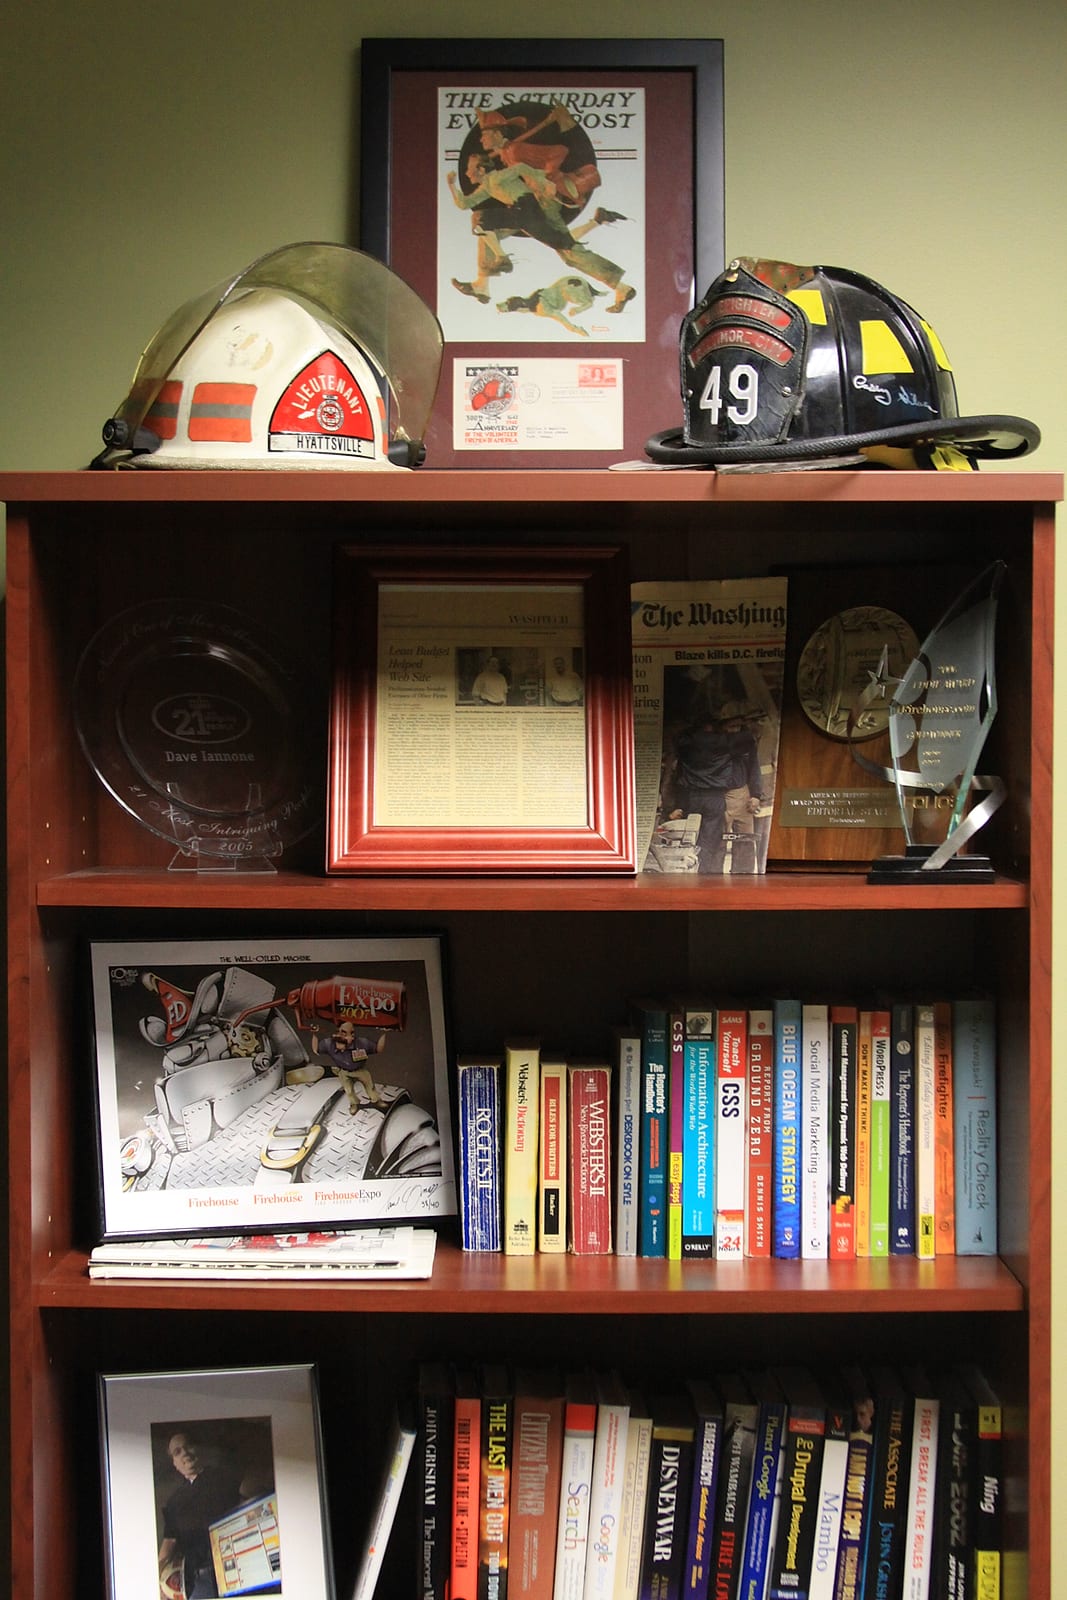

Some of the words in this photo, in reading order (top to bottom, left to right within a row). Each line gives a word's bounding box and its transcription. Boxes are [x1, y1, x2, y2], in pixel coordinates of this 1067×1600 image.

[445, 92, 493, 109] THE
[500, 92, 636, 113] SATURDAY
[291, 375, 363, 415] LIEUTENANT
[699, 363, 759, 425] 49
[296, 435, 362, 454] HYATTSVILLE
[642, 603, 684, 631] The
[688, 601, 786, 628] Washing
[388, 658, 424, 671] Helped
[415, 645, 450, 658] Budget
[675, 650, 705, 660] Blaze
[707, 649, 730, 660] kills
[732, 649, 754, 659] D.C.
[635, 668, 646, 678] to
[172, 708, 211, 736] 21
[165, 750, 197, 762] Dave
[200, 749, 255, 762] Iannone
[807, 807, 856, 816] EDITORIAL
[199, 819, 278, 838] Intriguing
[217, 841, 253, 852] 2005
[234, 955, 281, 963] WELL-OILED
[338, 985, 396, 1018] Expo
[352, 985, 395, 1000] Firehouse
[167, 1000, 188, 1025] FD
[339, 1006, 371, 1020] 2007
[672, 1021, 684, 1053] CSS
[688, 1046, 698, 1059] for
[721, 1031, 732, 1073] Yourself
[731, 1037, 741, 1066] Teach
[782, 1024, 797, 1063] BLUE
[840, 1029, 849, 1057] Content
[921, 1035, 933, 1063] Editing
[648, 1062, 664, 1073] The
[689, 1060, 697, 1071] the
[809, 1040, 821, 1073] Social
[861, 1043, 869, 1067] DON'T
[517, 1063, 530, 1104] Webster's
[689, 1073, 697, 1095] World
[697, 1047, 710, 1121] Information
[750, 1043, 761, 1107] GROUND
[763, 1066, 771, 1104] REPORT
[839, 1057, 849, 1102] Management
[861, 1069, 869, 1093] MAKE
[898, 1068, 911, 1084] The
[936, 1054, 949, 1119] Firefighter
[645, 1073, 655, 1114] Handbook
[654, 1073, 666, 1114] Reporter's
[689, 1096, 697, 1114] Wide
[721, 1082, 740, 1118] CSS
[782, 1069, 797, 1121] OCEAN
[809, 1077, 821, 1113] Media
[840, 1102, 849, 1114] for
[861, 1094, 869, 1106] ME
[897, 1084, 911, 1119] Reporter's
[548, 1099, 557, 1123] RULES
[579, 1104, 589, 1123] New
[689, 1114, 697, 1131] Web
[763, 1107, 771, 1133] FROM
[860, 1107, 868, 1133] THINK!
[475, 1107, 492, 1178] ROGET'S
[514, 1105, 528, 1152] Dictionary
[548, 1123, 557, 1139] FOR
[577, 1123, 589, 1156] Riverside
[588, 1100, 606, 1184] WEBSTER'S
[623, 1114, 632, 1163] DESKBOOK
[750, 1115, 761, 1156] ZERO
[838, 1114, 849, 1145] Dynamic
[898, 1119, 911, 1155] Handbook
[974, 1108, 990, 1159] Reality
[548, 1140, 557, 1177] WRITERS
[672, 1154, 682, 1162] in
[697, 1122, 710, 1199] Architecture
[807, 1117, 821, 1174] Marketing
[840, 1145, 849, 1161] Web
[579, 1156, 589, 1194] Dictionary
[623, 1165, 632, 1180] ON
[669, 1163, 681, 1180] easy
[782, 1126, 797, 1205] STRATEGY
[838, 1162, 848, 1192] Delivery
[253, 1194, 303, 1205] Firehouse
[314, 1189, 382, 1201] FirehouseExpo
[588, 1184, 606, 1198] II
[623, 1182, 632, 1206] STYLE
[670, 1182, 682, 1203] steps
[756, 1175, 764, 1212] DENNIS
[974, 1161, 990, 1210] Check
[188, 1197, 239, 1209] Firehouse
[548, 1194, 557, 1216] Hacker
[723, 1235, 741, 1249] 24
[756, 1216, 764, 1248] SMITH
[425, 1406, 437, 1443] JOHN
[457, 1418, 471, 1445] THIRTY
[488, 1403, 507, 1432] THE
[889, 1409, 902, 1434] THE
[919, 1408, 932, 1442] FIRST,
[520, 1412, 550, 1461] CITIZEN
[763, 1415, 780, 1452] Planet
[795, 1437, 815, 1450] Pro
[457, 1447, 470, 1470] YEARS
[487, 1436, 506, 1471] LAST
[700, 1421, 717, 1486] EMERGENCY!
[917, 1445, 930, 1483] BREAK
[424, 1443, 436, 1505] GRISHAM
[457, 1472, 470, 1483] ON
[755, 1454, 775, 1500] Google
[789, 1451, 812, 1502] Drupal
[847, 1475, 866, 1500] NOT
[883, 1436, 902, 1510] ASSOCIATE
[456, 1485, 469, 1499] THE
[486, 1475, 505, 1509] MEN
[517, 1463, 549, 1516] TURNER
[652, 1445, 681, 1562] DISNEYWAR
[724, 1456, 741, 1523] WAMBAUGH
[915, 1485, 928, 1507] ALL
[979, 1475, 999, 1514] Ning
[456, 1501, 469, 1517] LINE
[564, 1482, 589, 1551] Search
[914, 1509, 926, 1529] THE
[423, 1517, 436, 1539] The
[486, 1512, 504, 1543] OUT
[593, 1513, 615, 1562] Google
[785, 1503, 804, 1570] Development
[815, 1490, 840, 1572] Mambo
[877, 1521, 896, 1559] JOHN
[454, 1527, 469, 1568] STAPLETON
[488, 1551, 500, 1574] TOM
[717, 1531, 736, 1568] FIRE
[912, 1534, 925, 1569] RULES
[423, 1540, 435, 1588] Innocent
